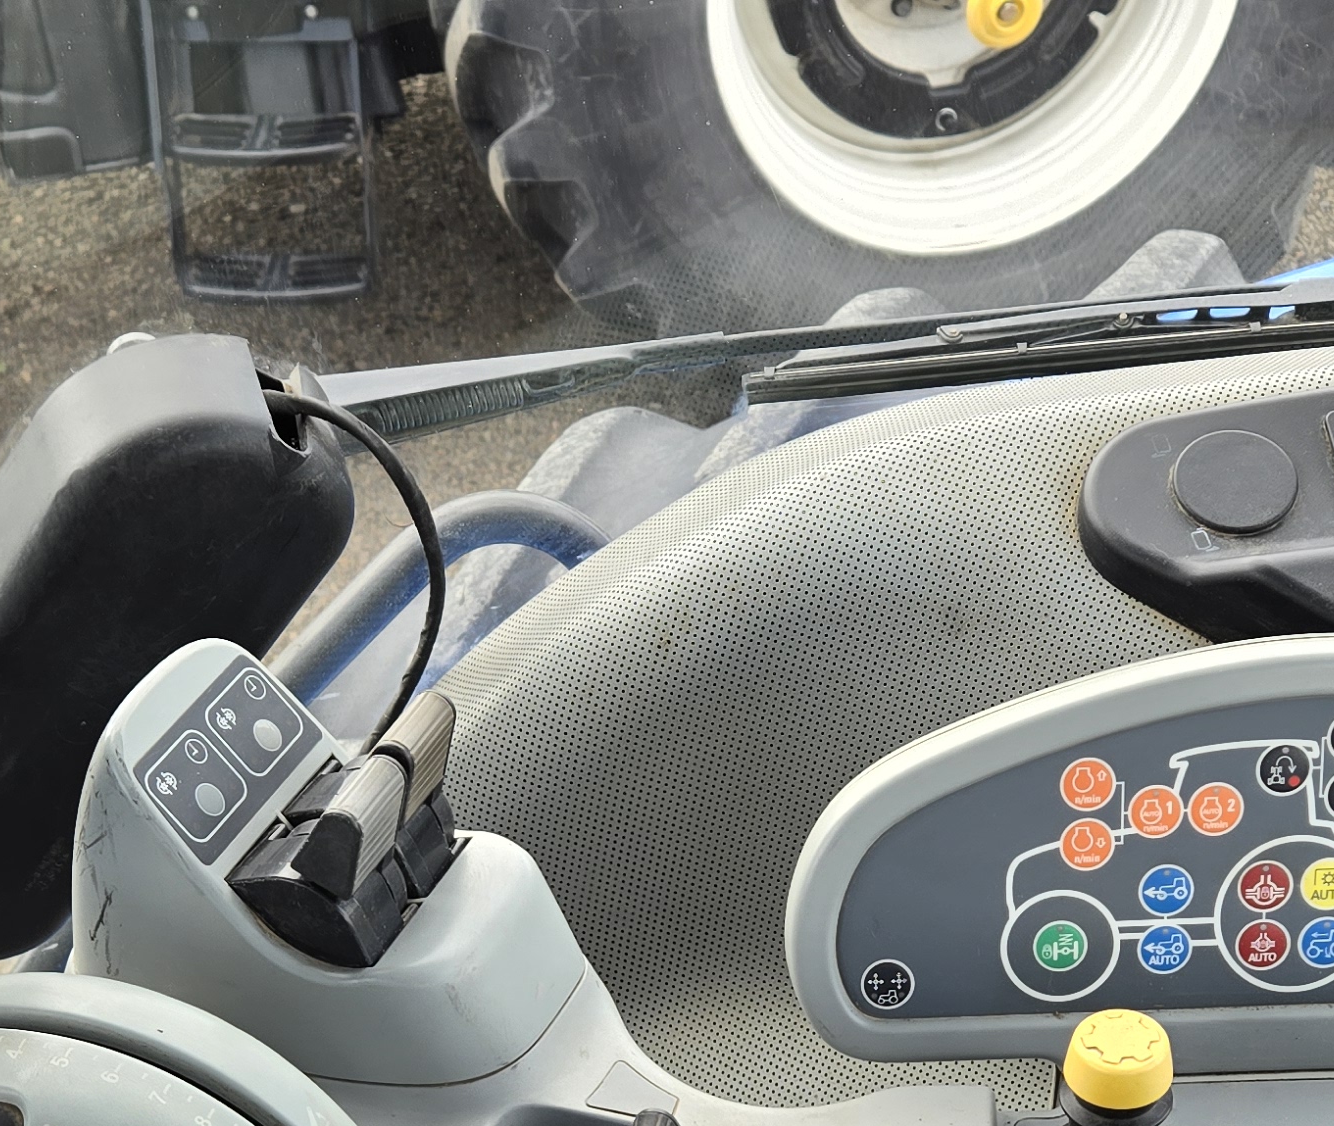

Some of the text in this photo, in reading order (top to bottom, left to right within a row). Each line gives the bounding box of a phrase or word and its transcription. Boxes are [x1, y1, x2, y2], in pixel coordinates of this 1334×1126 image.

[1074, 794, 1101, 805] n/min
[1227, 799, 1236, 813] 2
[1166, 801, 1173, 815] 1
[1143, 823, 1168, 833] n/min
[1202, 820, 1229, 830] n/min
[1074, 854, 1101, 864] n/min
[1148, 953, 1180, 966] AUTO
[1247, 951, 1277, 962] AUTO
[5, 1046, 24, 1060] 4
[49, 1055, 70, 1068] 5
[100, 1069, 120, 1084] 6
[148, 1090, 167, 1105] 7
